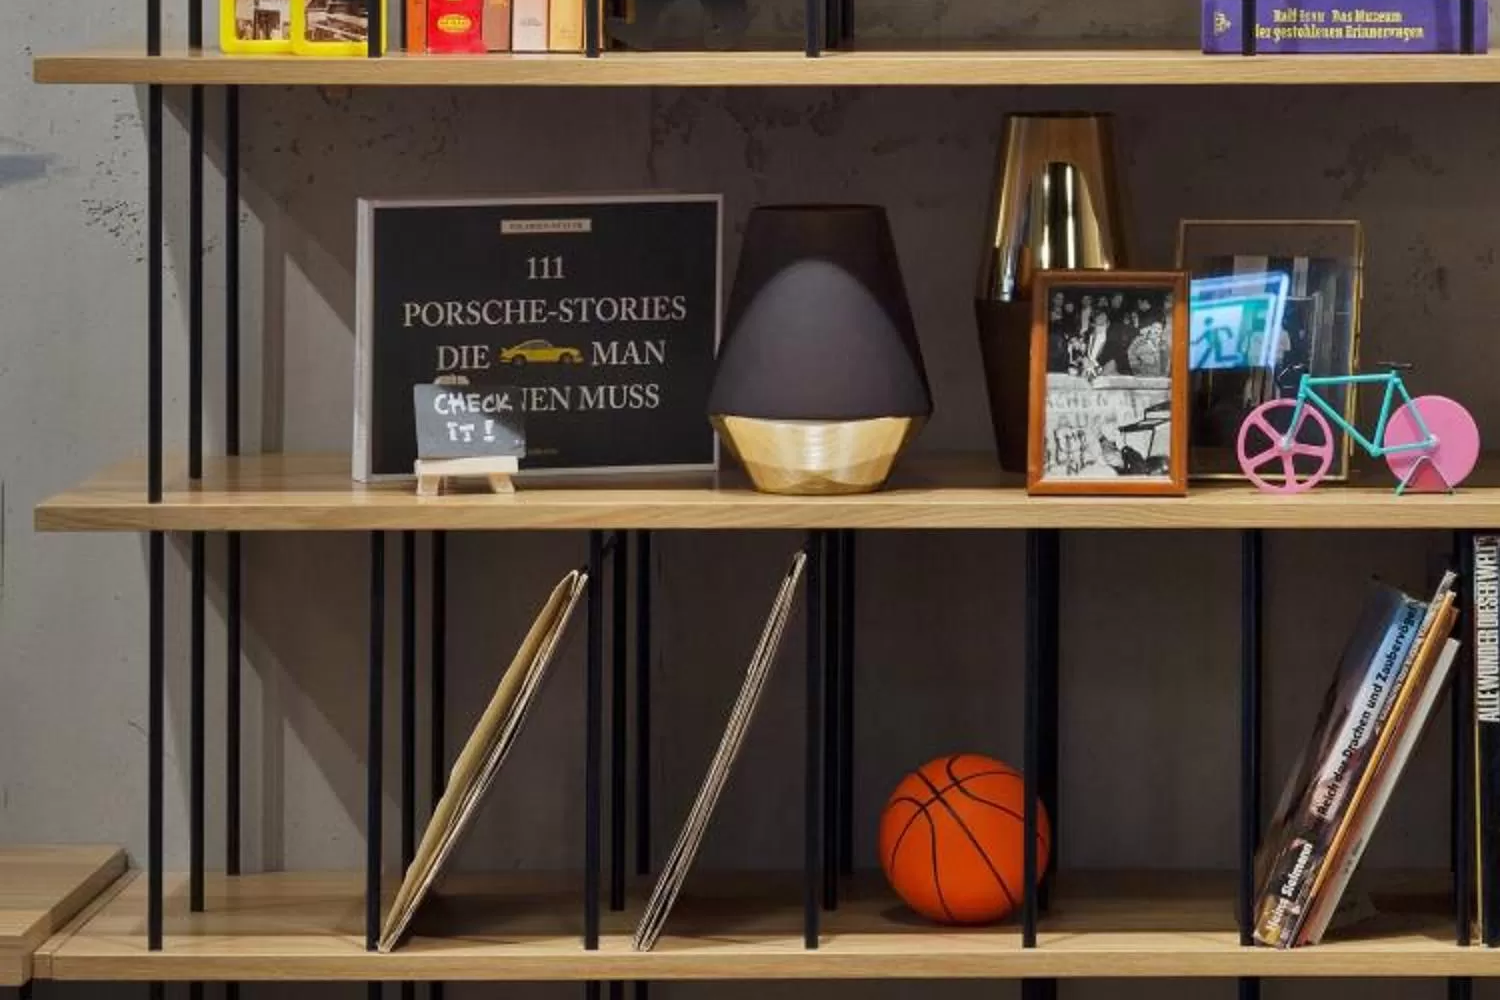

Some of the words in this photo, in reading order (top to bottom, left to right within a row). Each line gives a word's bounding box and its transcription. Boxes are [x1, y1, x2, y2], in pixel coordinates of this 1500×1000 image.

[526, 256, 566, 280] 111
[402, 295, 687, 328] PORSCHE-STORIES
[436, 345, 490, 371] DIE
[592, 340, 667, 366] MAN
[433, 392, 514, 415] CHECK
[579, 384, 660, 411] MUSS
[1366, 684, 1385, 709] und
